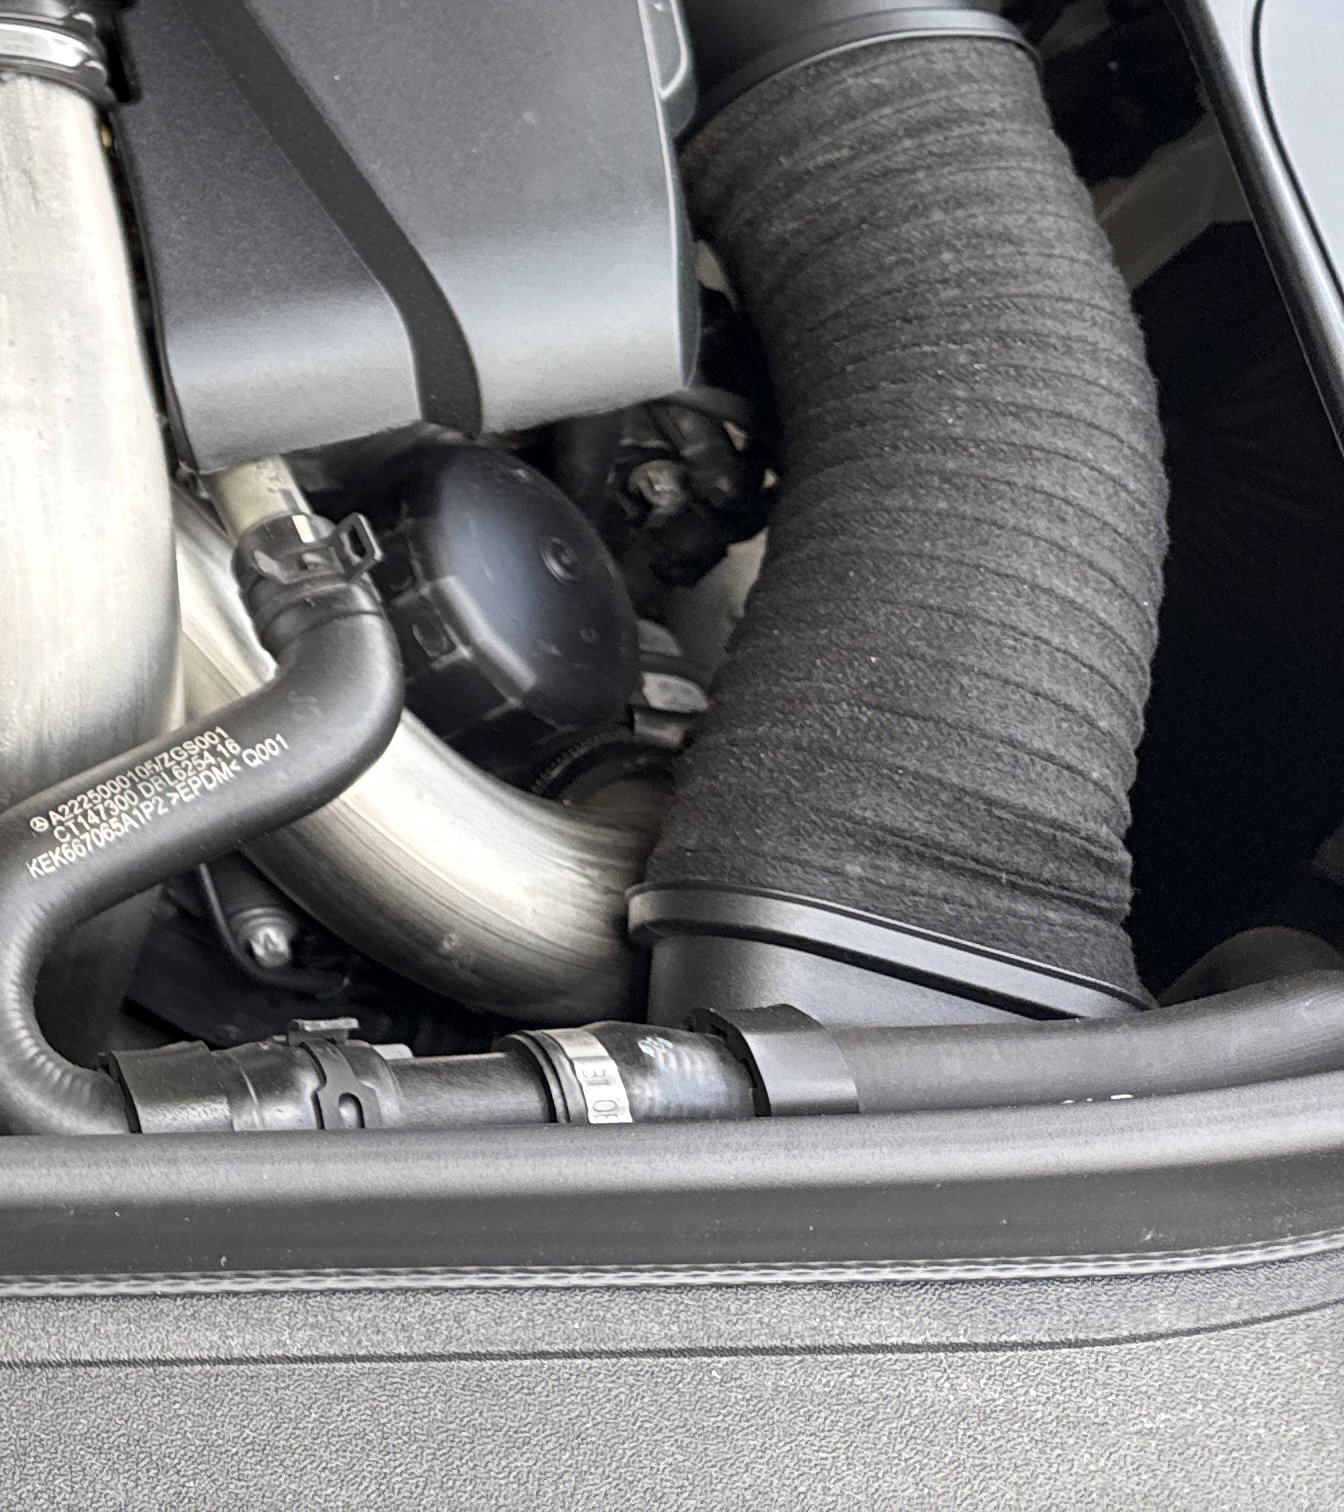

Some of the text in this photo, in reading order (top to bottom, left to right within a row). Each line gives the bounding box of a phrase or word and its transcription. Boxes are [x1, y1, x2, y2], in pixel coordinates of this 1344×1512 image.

[26, 796, 169, 879] KEK667065A1P2
[241, 733, 290, 768] Q001
[49, 726, 230, 826] A2225000105/ZGS001
[53, 789, 139, 843] CT147300
